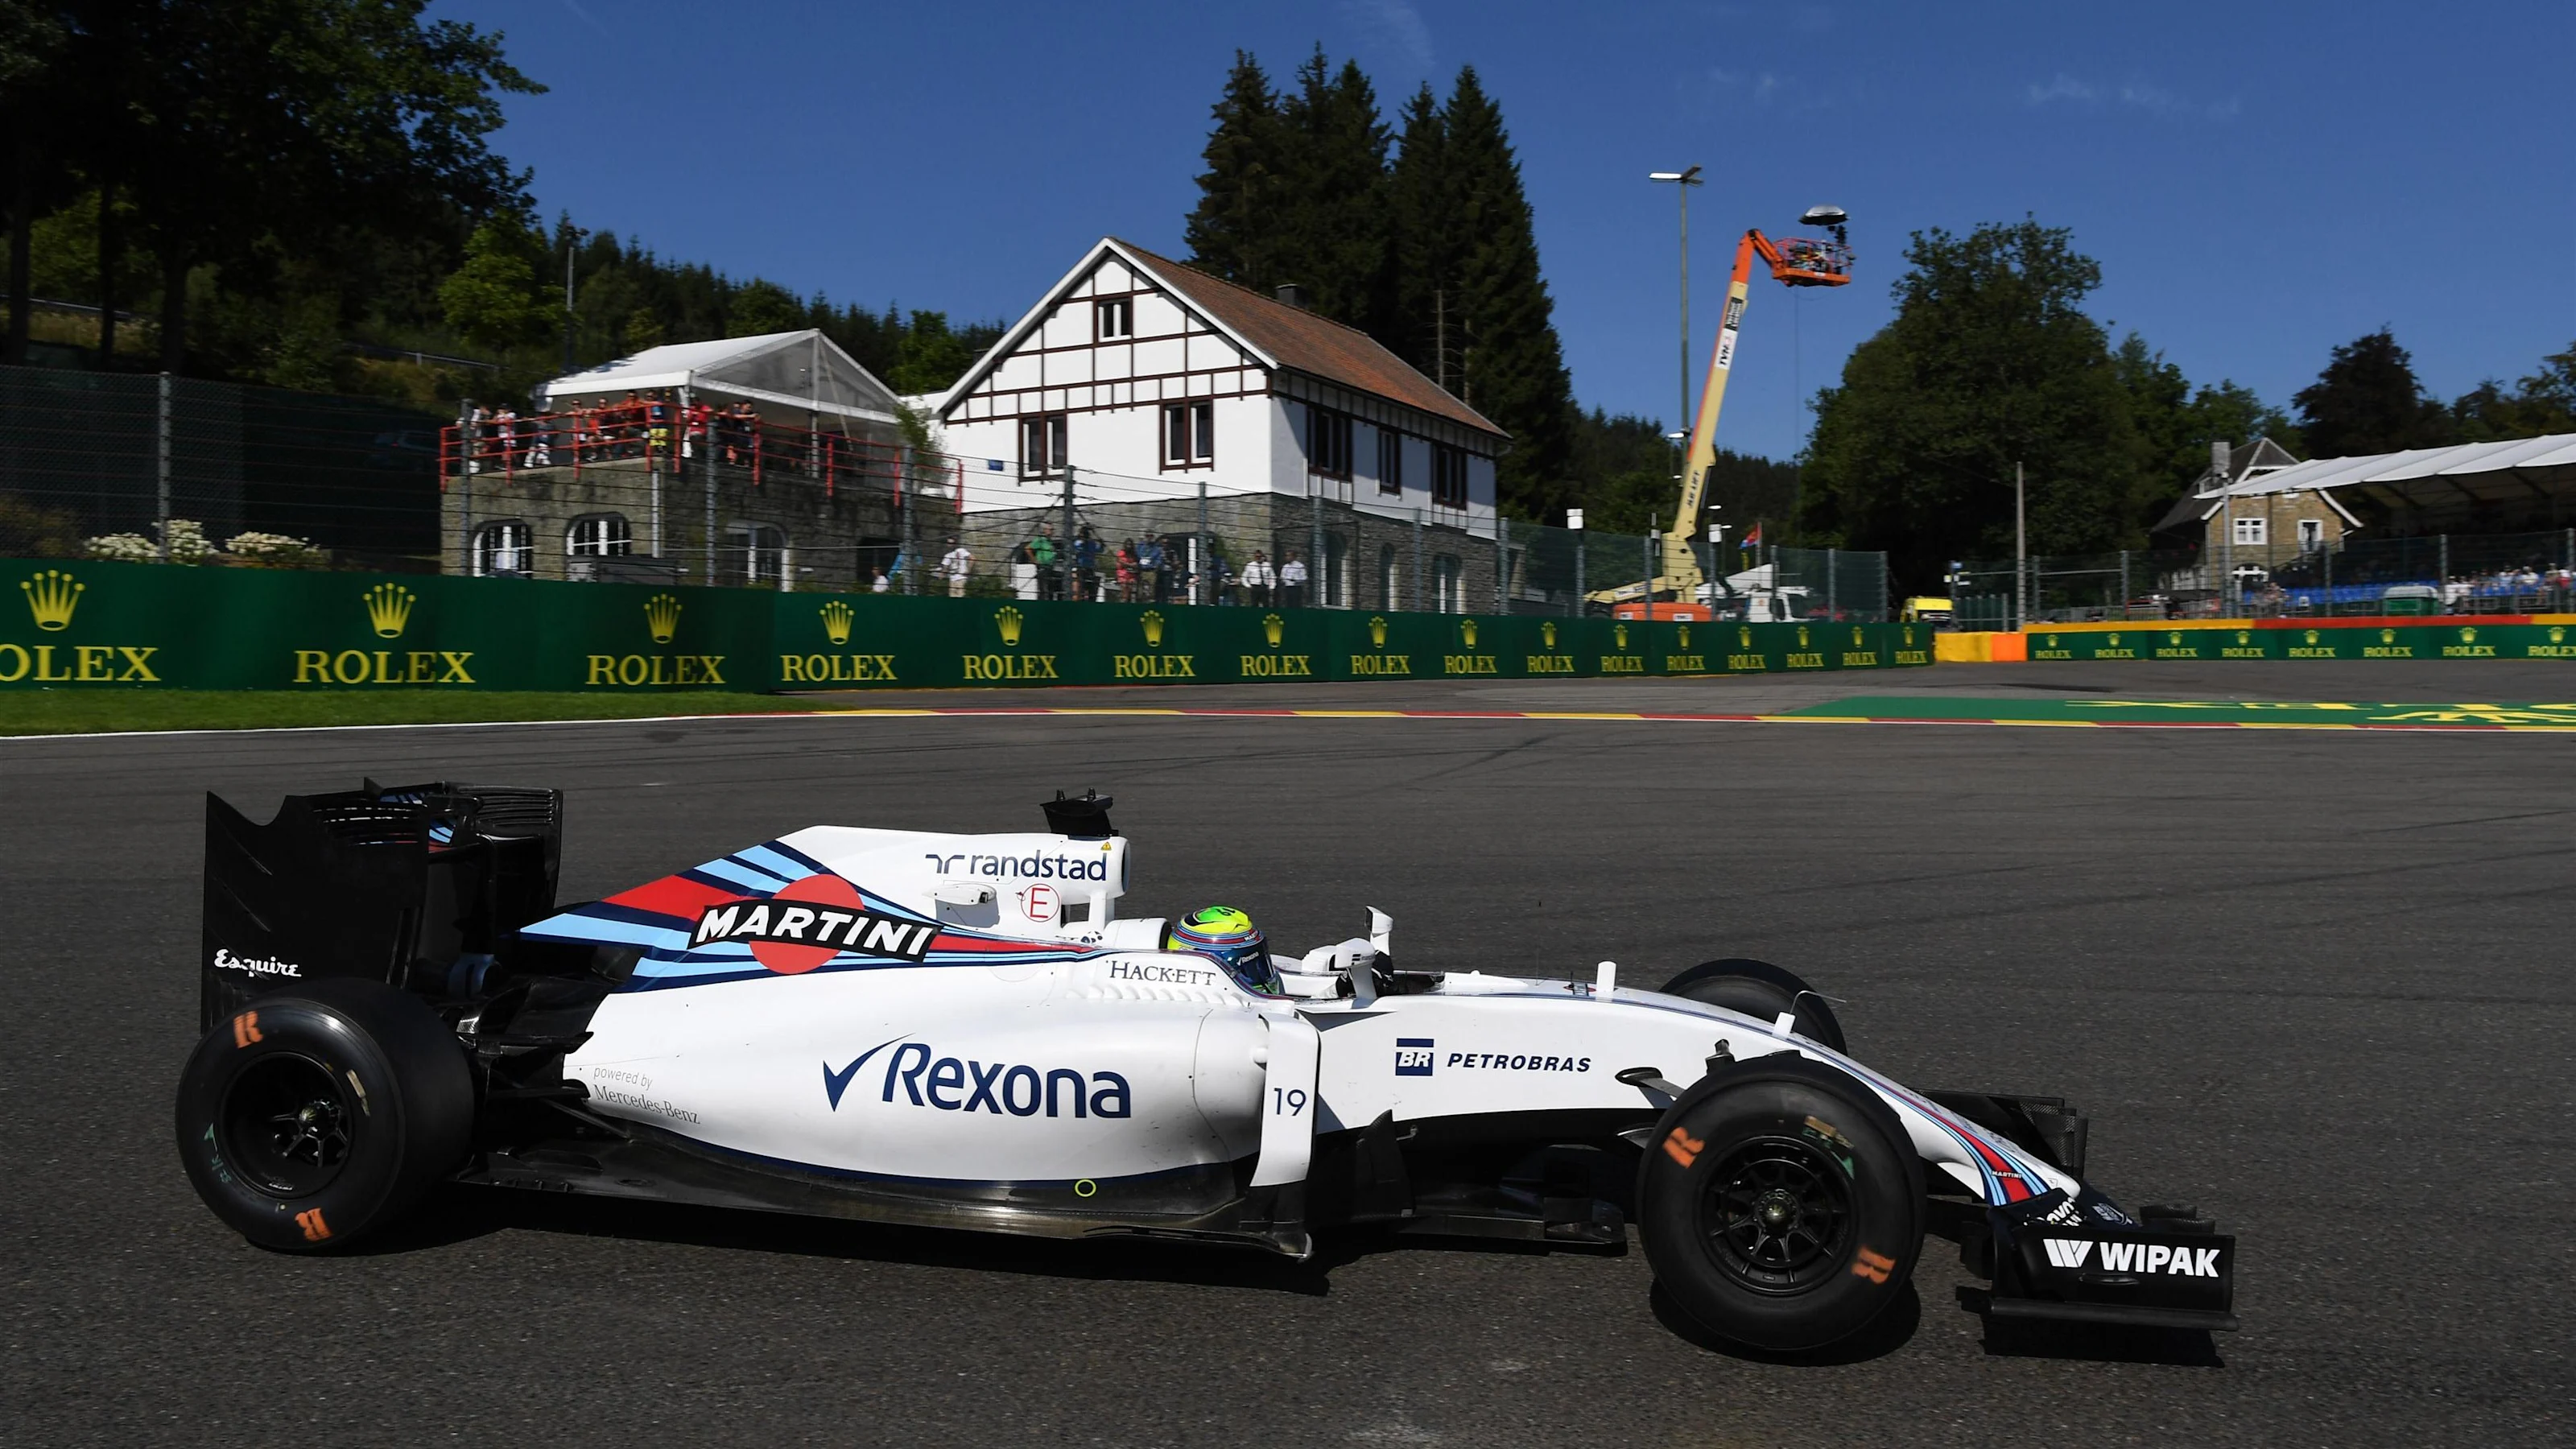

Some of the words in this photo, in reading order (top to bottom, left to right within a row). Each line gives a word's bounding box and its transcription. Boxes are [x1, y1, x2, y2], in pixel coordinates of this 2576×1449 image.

[1728, 654, 1765, 670] ROLEX
[1786, 653, 1823, 668] ROLEX
[1843, 651, 1877, 666] ROLEX
[1895, 650, 1927, 664] ROLEX
[2035, 650, 2071, 659] ROLEX
[2095, 649, 2134, 658] ROLEX
[2156, 648, 2197, 658] ROLEX
[2222, 647, 2264, 658] ROLEX
[2288, 647, 2335, 658] ROLEX
[2363, 646, 2413, 658] ROLEX
[2442, 646, 2496, 657] ROLEX
[0, 643, 161, 683] OLEX
[295, 650, 475, 684] ROLEX
[586, 654, 725, 686] ROLEX
[781, 654, 897, 682] ROLEX
[963, 654, 1059, 680] ROLEX
[1114, 654, 1196, 678] ROLEX
[1241, 654, 1311, 676] ROLEX
[1350, 654, 1411, 675] ROLEX
[1444, 655, 1497, 674] ROLEX
[1526, 655, 1575, 673] ROLEX
[1600, 655, 1644, 672] ROLEX
[1666, 655, 1705, 671] ROLEX
[970, 849, 1107, 881] randstad
[1030, 887, 1051, 919] E
[696, 904, 935, 956] MARTINI
[213, 948, 302, 977] Esquire
[1109, 960, 1216, 986] HACKETT
[1397, 1051, 1433, 1068] BR
[1447, 1053, 1591, 1072] PETROBRAS
[593, 1067, 639, 1085] powered
[641, 1074, 653, 1091] by
[882, 1042, 1132, 1120] Rexona
[593, 1084, 700, 1125] Mercedes-Benz
[1274, 1087, 1307, 1117] 19
[1991, 1170, 2023, 1179] MARTINI
[2099, 1242, 2220, 1278] WIPAK
